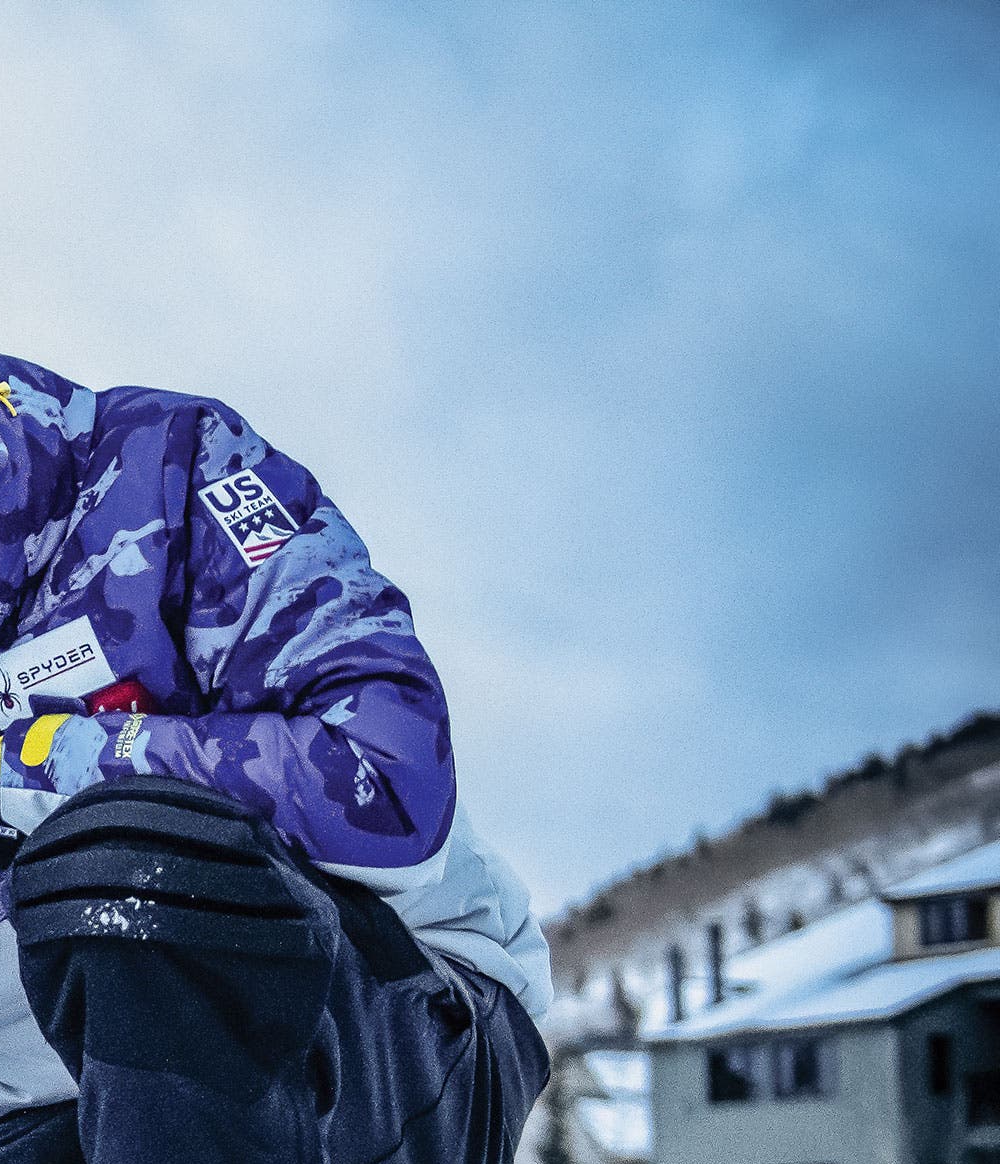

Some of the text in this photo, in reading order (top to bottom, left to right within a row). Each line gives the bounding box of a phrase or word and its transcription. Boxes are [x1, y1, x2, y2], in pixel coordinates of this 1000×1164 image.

[204, 475, 263, 513] US
[223, 495, 273, 525] SKI TEAM
[17, 643, 94, 684] SPYDER
